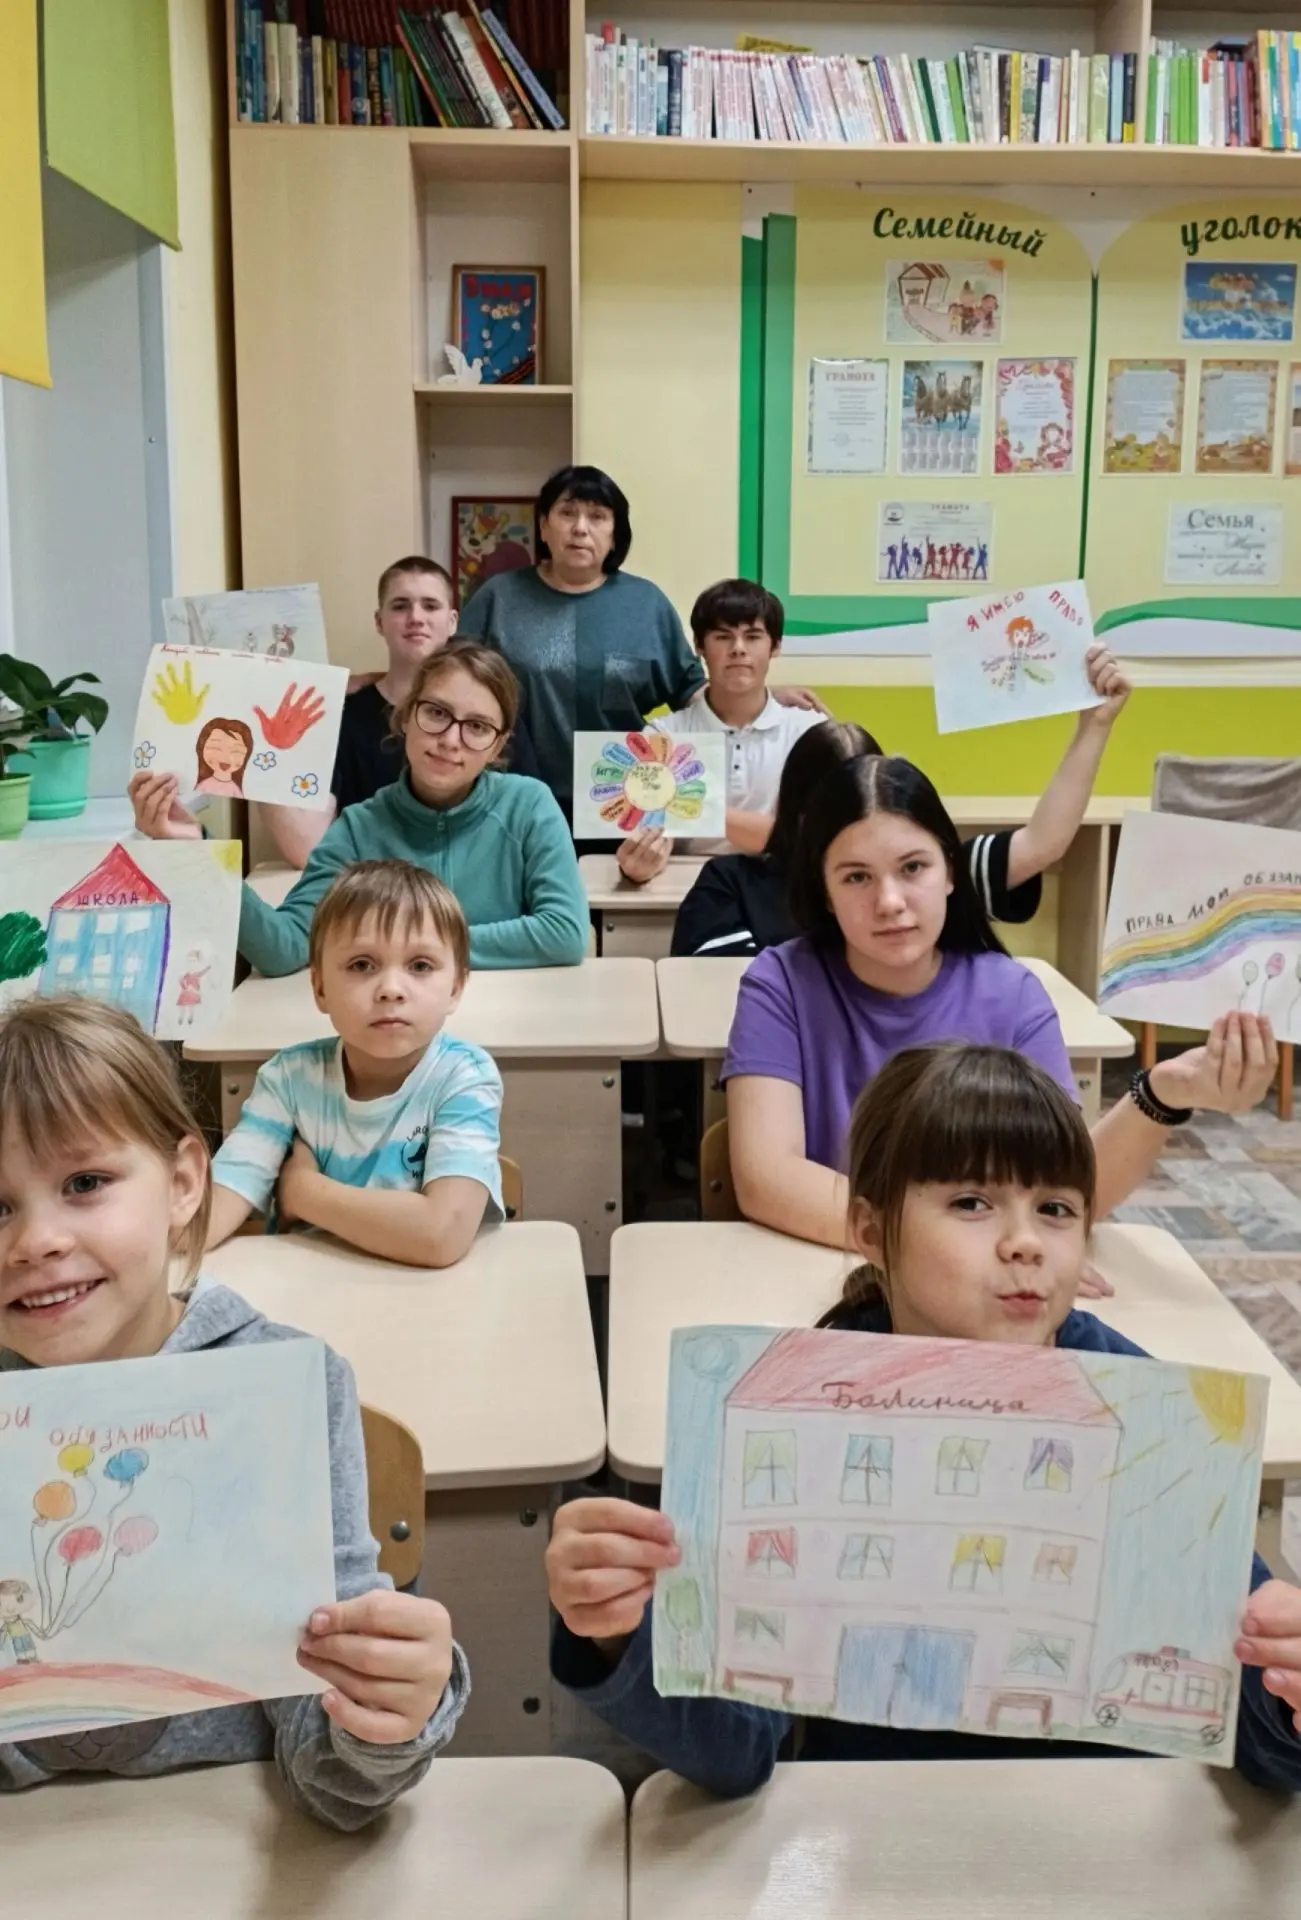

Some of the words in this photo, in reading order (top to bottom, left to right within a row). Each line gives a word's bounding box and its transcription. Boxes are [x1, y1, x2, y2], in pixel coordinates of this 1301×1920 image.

[873, 207, 1047, 257] Семейный
[1181, 214, 1301, 256] уголок
[1188, 508, 1255, 529] Семья
[967, 614, 980, 632] Я
[77, 892, 142, 907] ШКОЛА
[1126, 912, 1175, 934] ПРАВА
